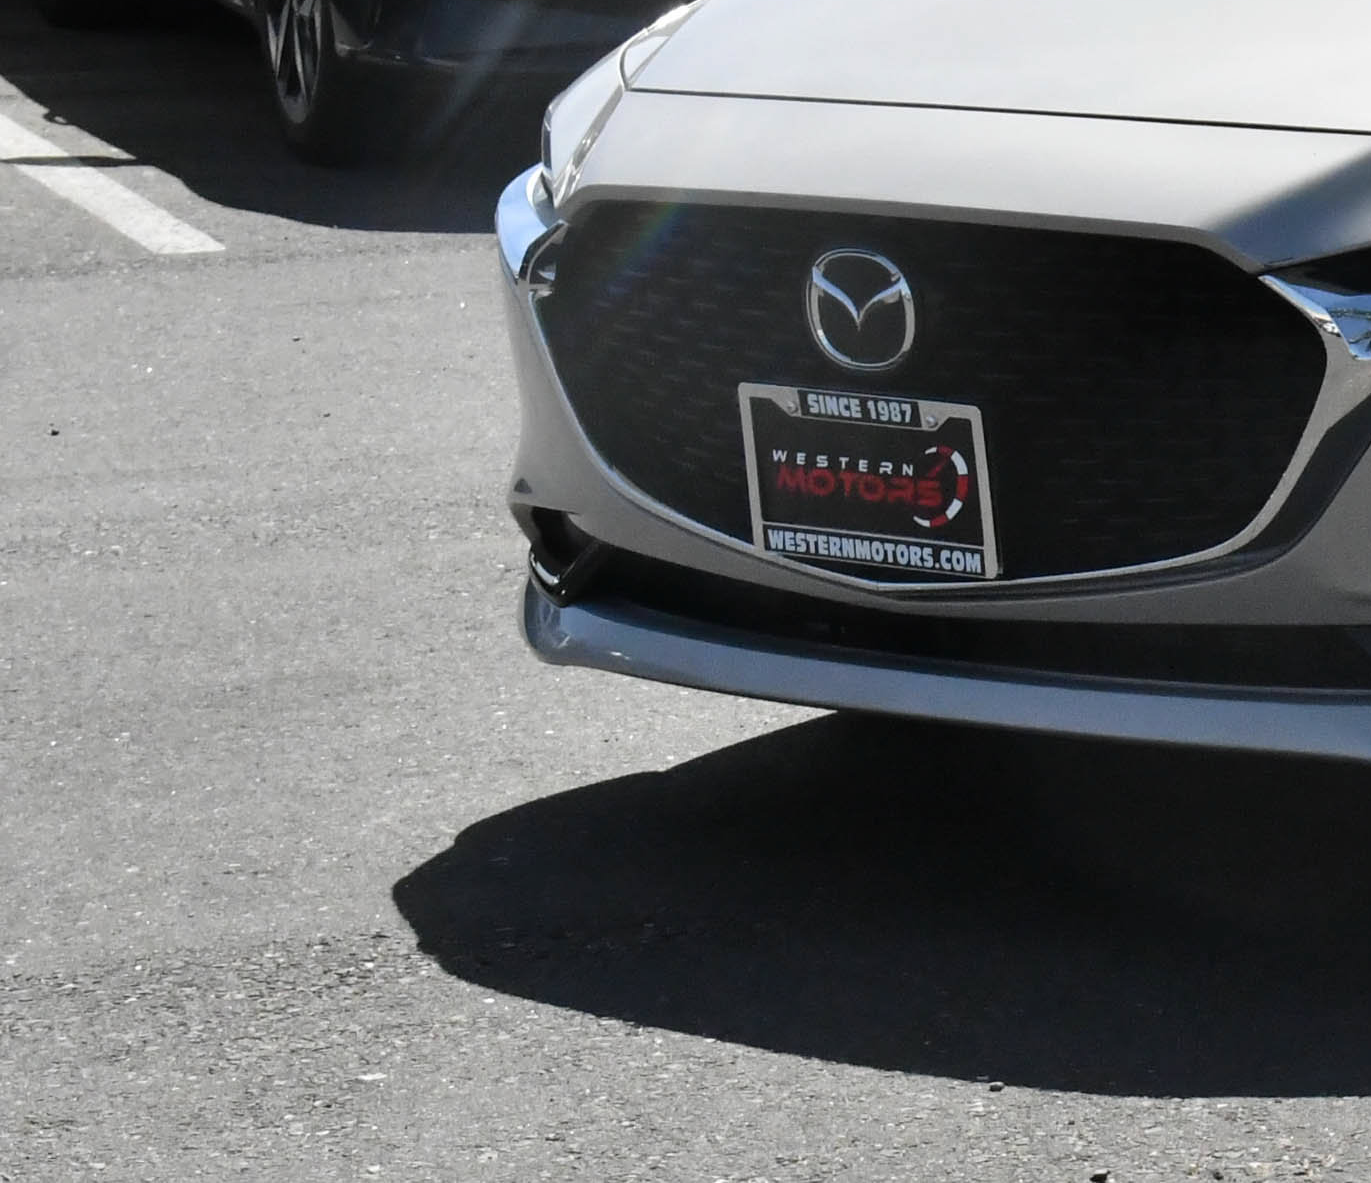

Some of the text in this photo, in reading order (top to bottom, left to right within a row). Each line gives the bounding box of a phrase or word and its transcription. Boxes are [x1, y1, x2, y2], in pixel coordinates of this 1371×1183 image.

[806, 393, 912, 423] SINCE 1987
[772, 449, 914, 477] WESTERN
[776, 465, 943, 508] MOTORS
[767, 529, 982, 573] WESTERNMOTORS.COM
